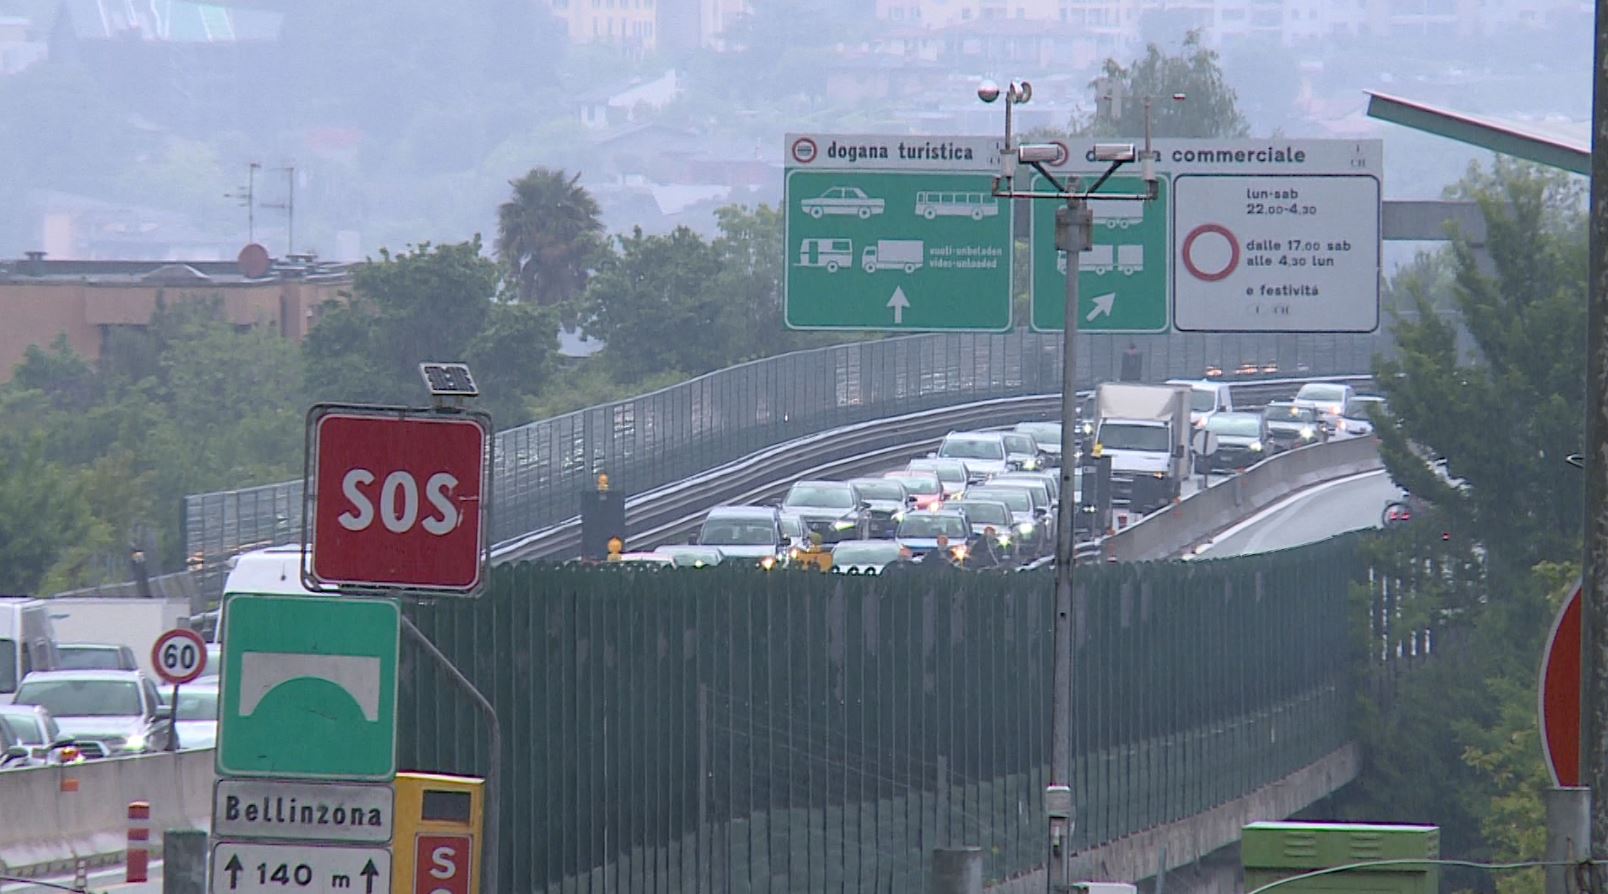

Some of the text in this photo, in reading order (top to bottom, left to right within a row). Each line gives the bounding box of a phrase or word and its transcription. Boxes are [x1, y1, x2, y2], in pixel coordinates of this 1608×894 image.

[828, 141, 974, 161] dogana turistica
[1172, 147, 1306, 163] commerciale
[1247, 188, 1298, 199] lun-sab
[1246, 240, 1351, 251] dalle 17.00 sab
[1247, 255, 1272, 266] alle
[1312, 256, 1334, 266] lun
[1246, 287, 1254, 296] e
[338, 469, 459, 536] SOS
[163, 643, 195, 669] 60
[225, 795, 381, 826] Bellinzona
[257, 863, 350, 888] 140 m
